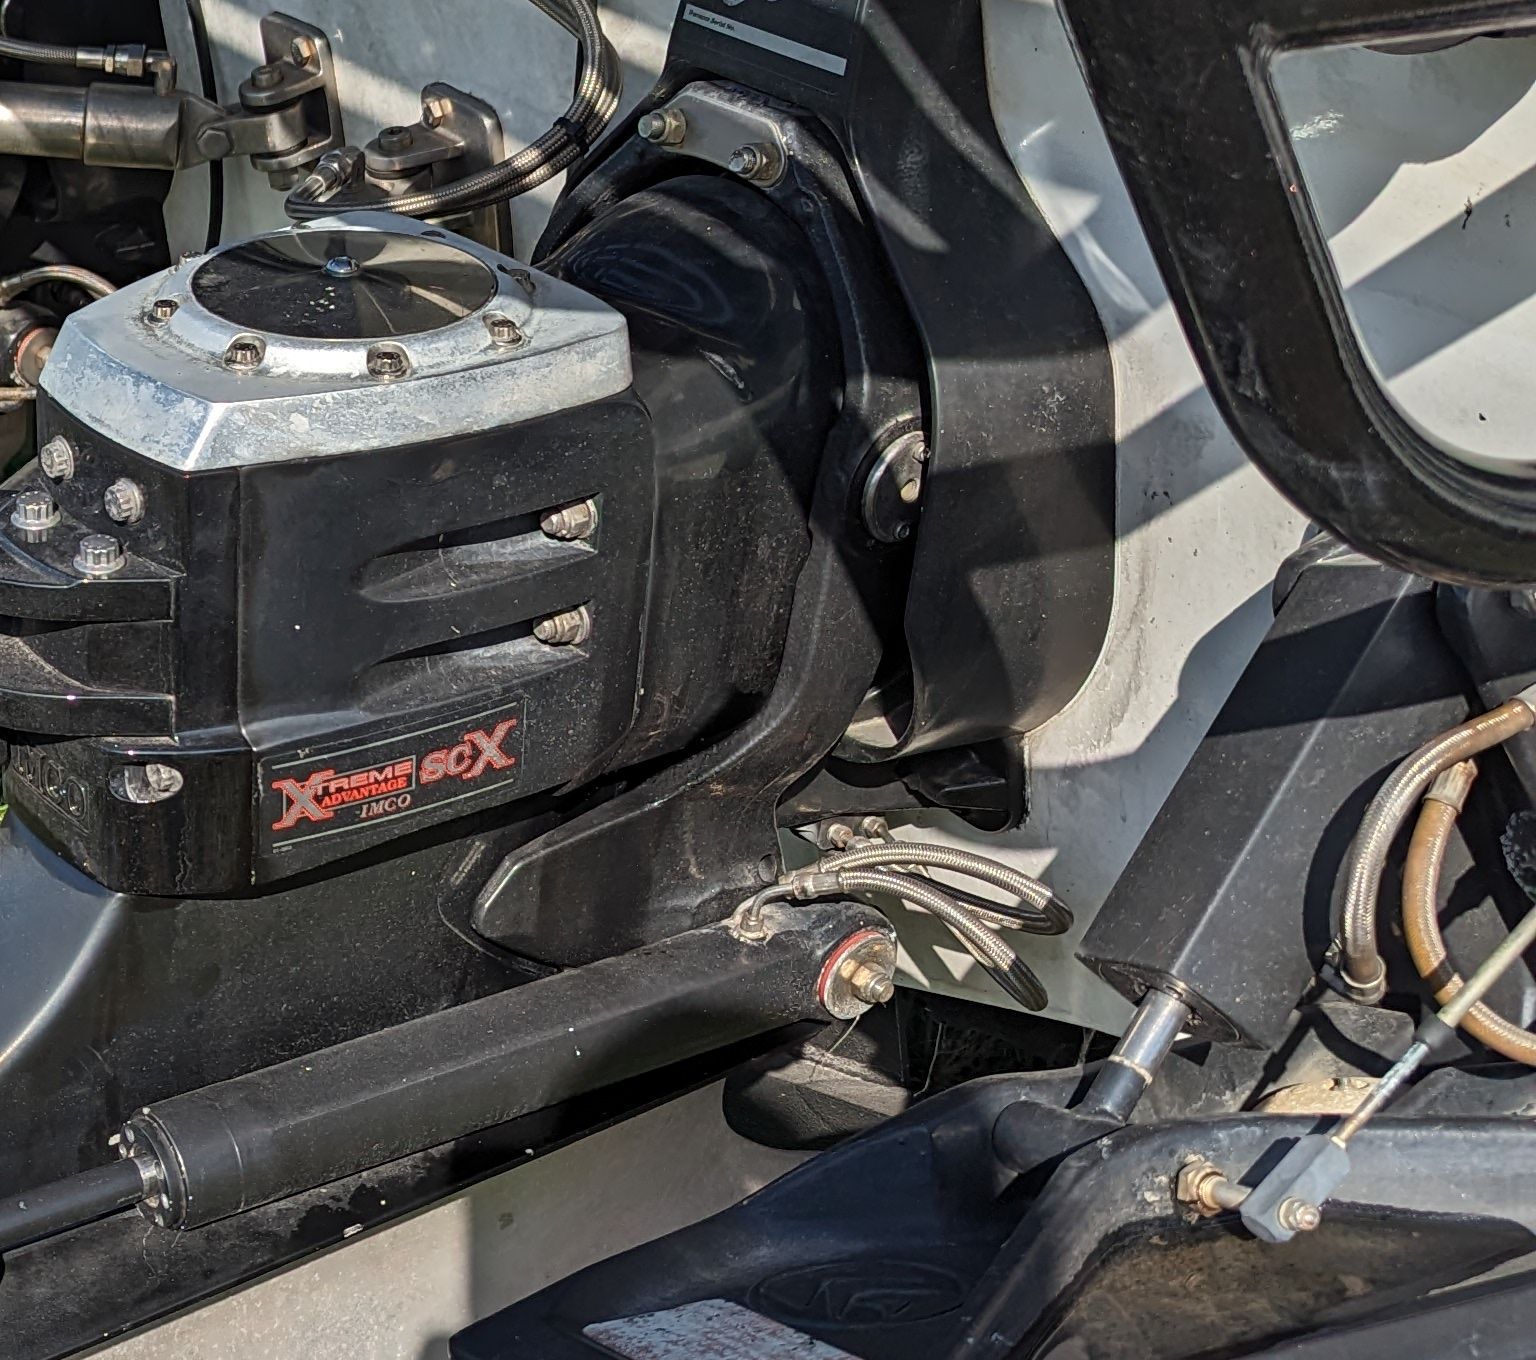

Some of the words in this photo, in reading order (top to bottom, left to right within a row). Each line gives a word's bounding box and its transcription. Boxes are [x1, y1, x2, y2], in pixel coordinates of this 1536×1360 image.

[271, 760, 414, 830] XTREME
[419, 718, 517, 785] SCX
[321, 776, 408, 808] ADVANTAGE
[359, 794, 412, 818] IMCO
